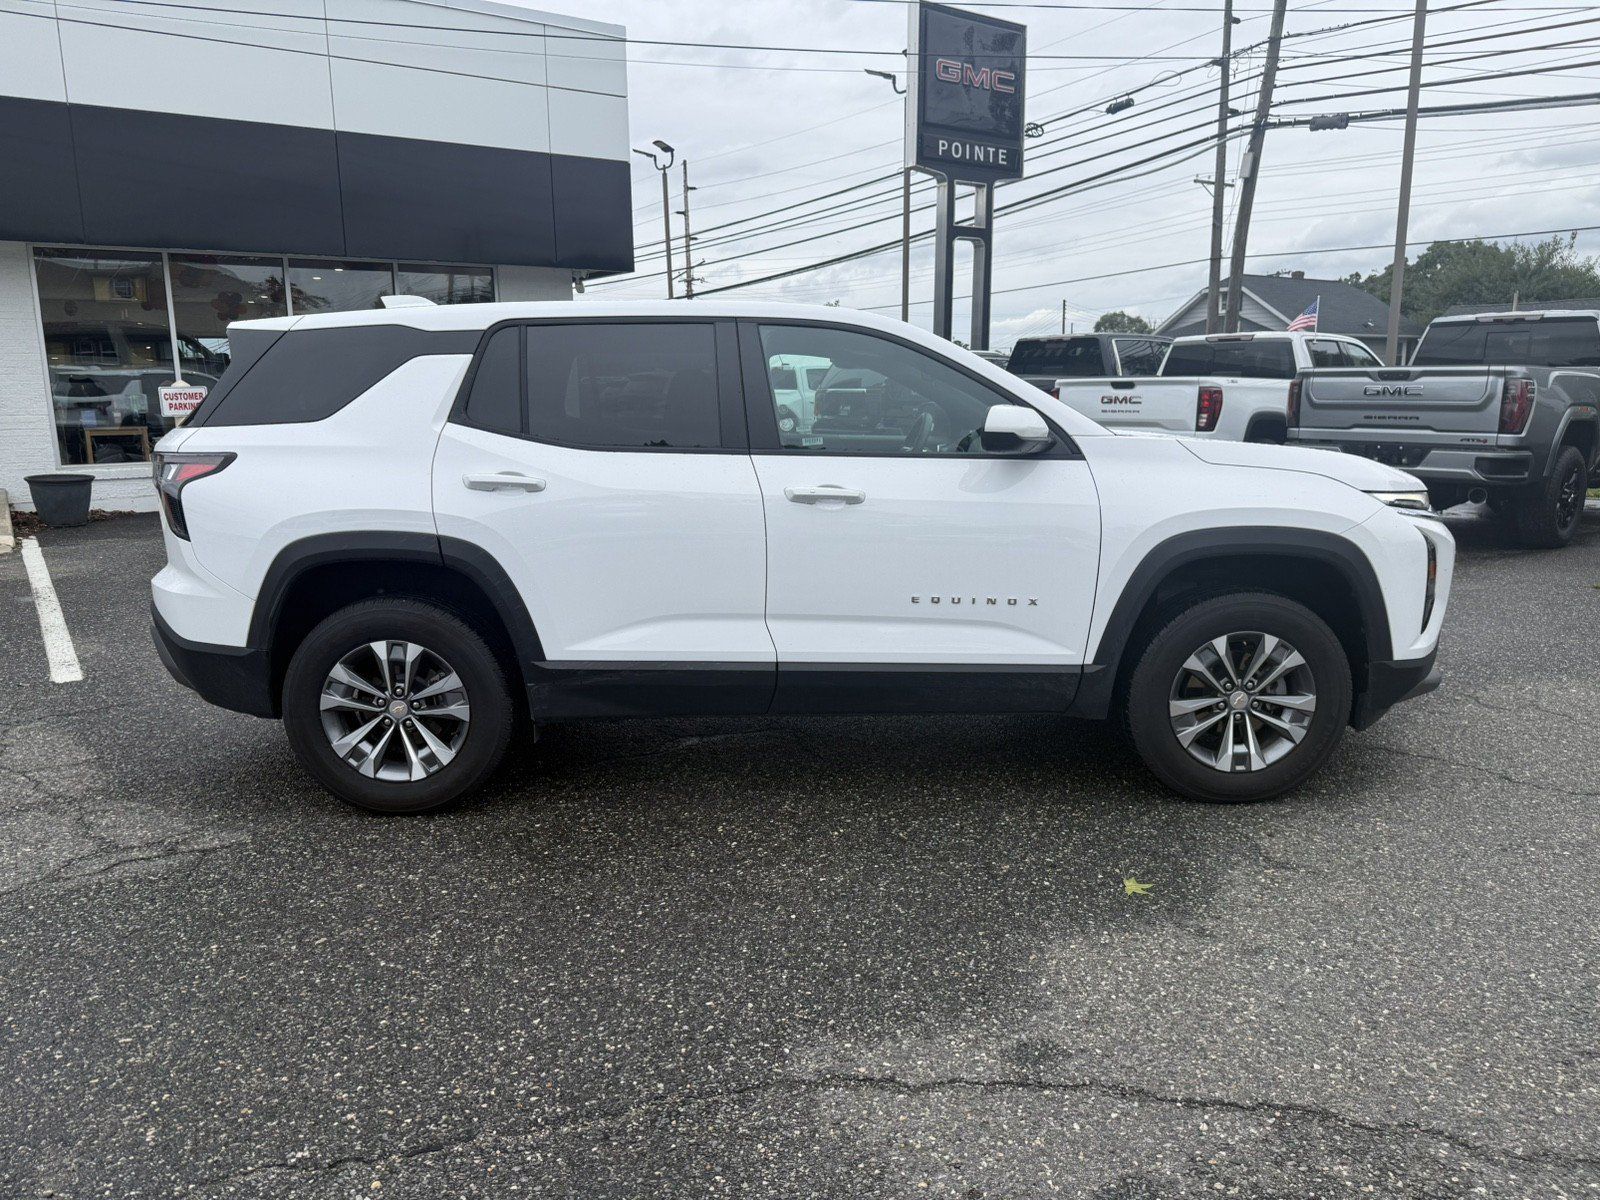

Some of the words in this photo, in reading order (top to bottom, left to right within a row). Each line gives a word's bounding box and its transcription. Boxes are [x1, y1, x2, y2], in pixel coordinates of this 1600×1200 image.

[936, 58, 1015, 94] GMC
[938, 139, 1007, 165] POINTE
[1363, 385, 1424, 396] GMC
[164, 392, 204, 401] CUSTOMER
[1101, 395, 1142, 405] GMC
[911, 596, 1039, 606] EQUINOX
